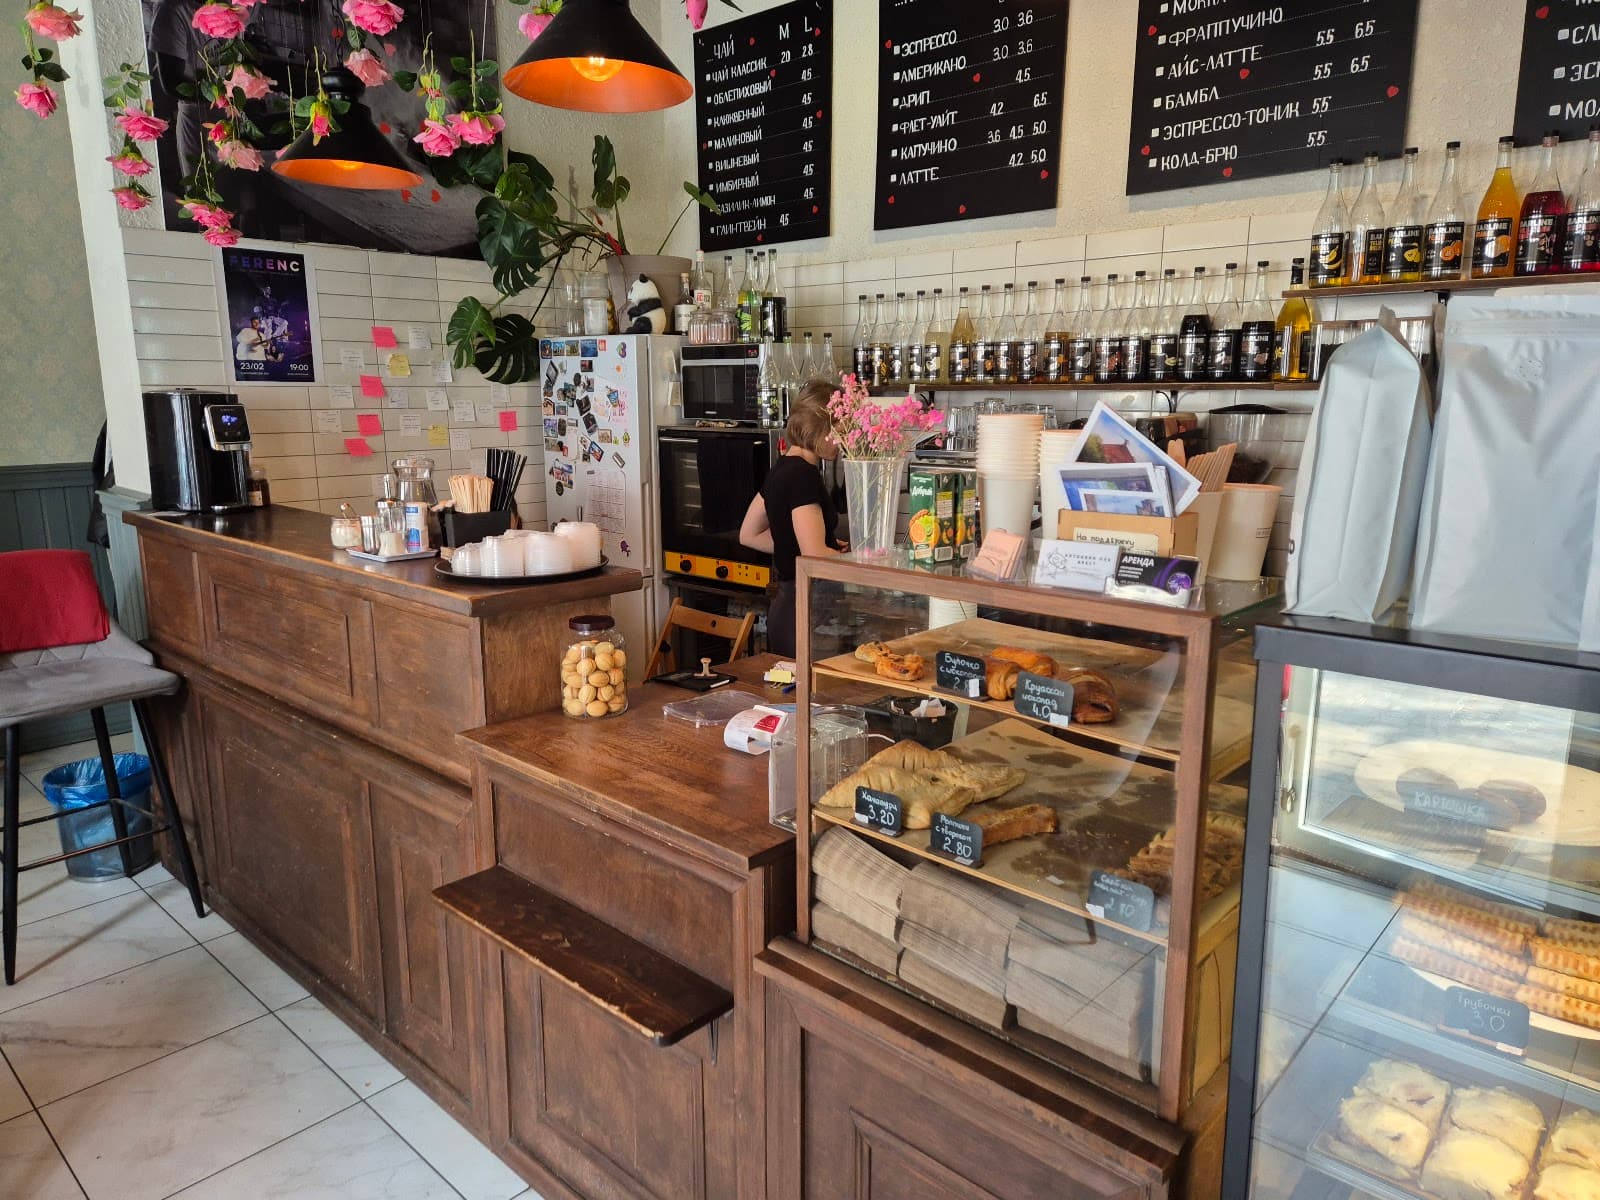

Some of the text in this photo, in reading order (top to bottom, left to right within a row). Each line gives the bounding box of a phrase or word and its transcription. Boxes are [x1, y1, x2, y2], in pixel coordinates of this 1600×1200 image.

[804, 16, 813, 32] L
[1169, 7, 1283, 46] ФРАППУЧИНО
[901, 30, 957, 57] ЭСПРЕССО
[712, 65, 729, 83] ЧАЙ
[731, 57, 767, 79] КЛАССИК
[900, 55, 967, 84] АМЕРИКАНО
[1168, 44, 1264, 79] АЙС-ЛАТТЕ
[713, 75, 772, 105] ОБЛЕПИХОВЫЙ
[899, 90, 930, 109] ДРИП
[1166, 86, 1219, 111] БАМБЛ
[900, 109, 958, 135] ФЛЕТ-УАЙТ
[1162, 101, 1300, 141] ЭСПРЕССО-ТОНИК
[714, 125, 762, 150] МАЛИНОВЫЙ
[900, 137, 958, 160] КАПУЧИНО
[1161, 145, 1238, 171] КОЛД-БРЮ
[715, 171, 759, 193] ИМБИРНЫЙ
[899, 166, 940, 186] ЛАТТЕ
[716, 216, 766, 236] ГЛИНТВЕЙН
[240, 361, 265, 371] 23/02
[1121, 555, 1155, 568] АРЕНДА
[944, 652, 980, 669] Булочка
[868, 804, 895, 826] 3.20
[943, 836, 972, 858] 2.80
